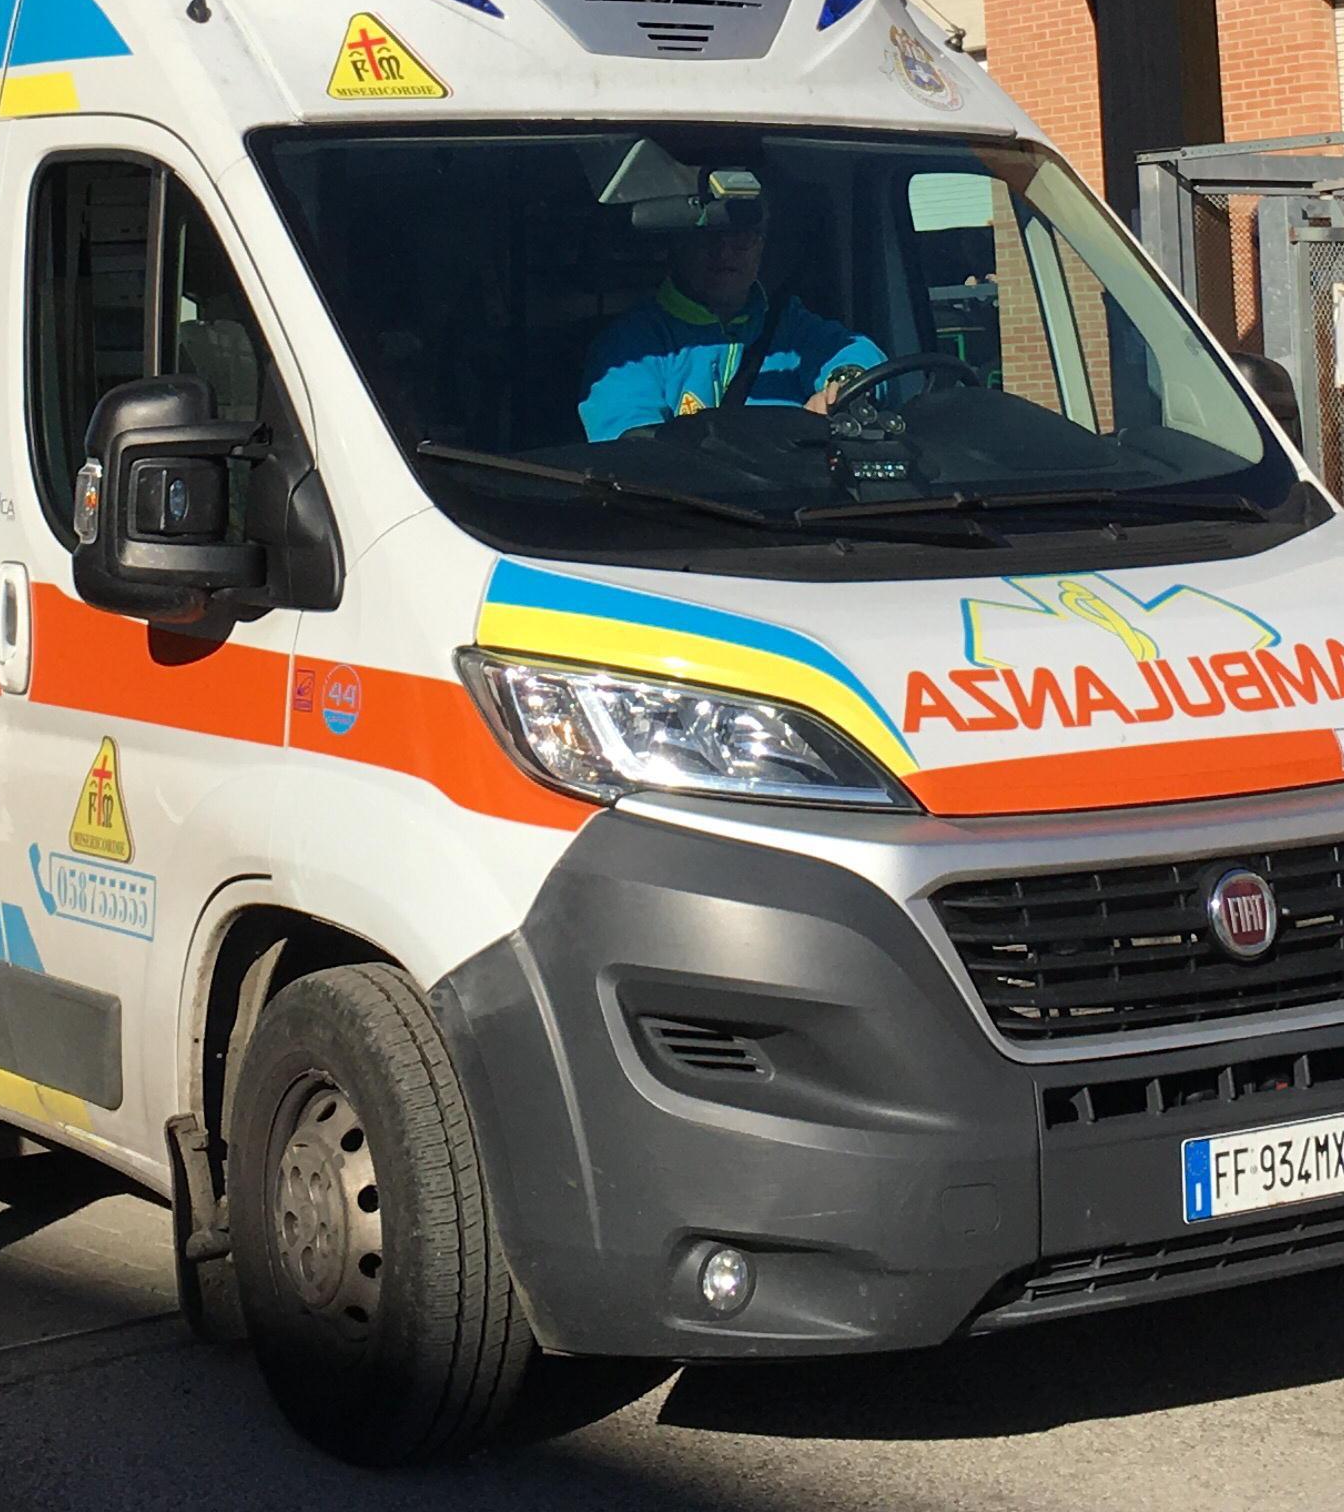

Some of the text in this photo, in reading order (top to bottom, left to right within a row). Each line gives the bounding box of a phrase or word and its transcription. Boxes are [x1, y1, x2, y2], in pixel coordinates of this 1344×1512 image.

[335, 85, 436, 97] MISERICORDIE
[328, 682, 355, 708] 44
[73, 830, 126, 857] MISERICORDIE
[57, 865, 149, 930] 058755555
[1227, 893, 1266, 934] FIAT
[1215, 1146, 1249, 1199] FF
